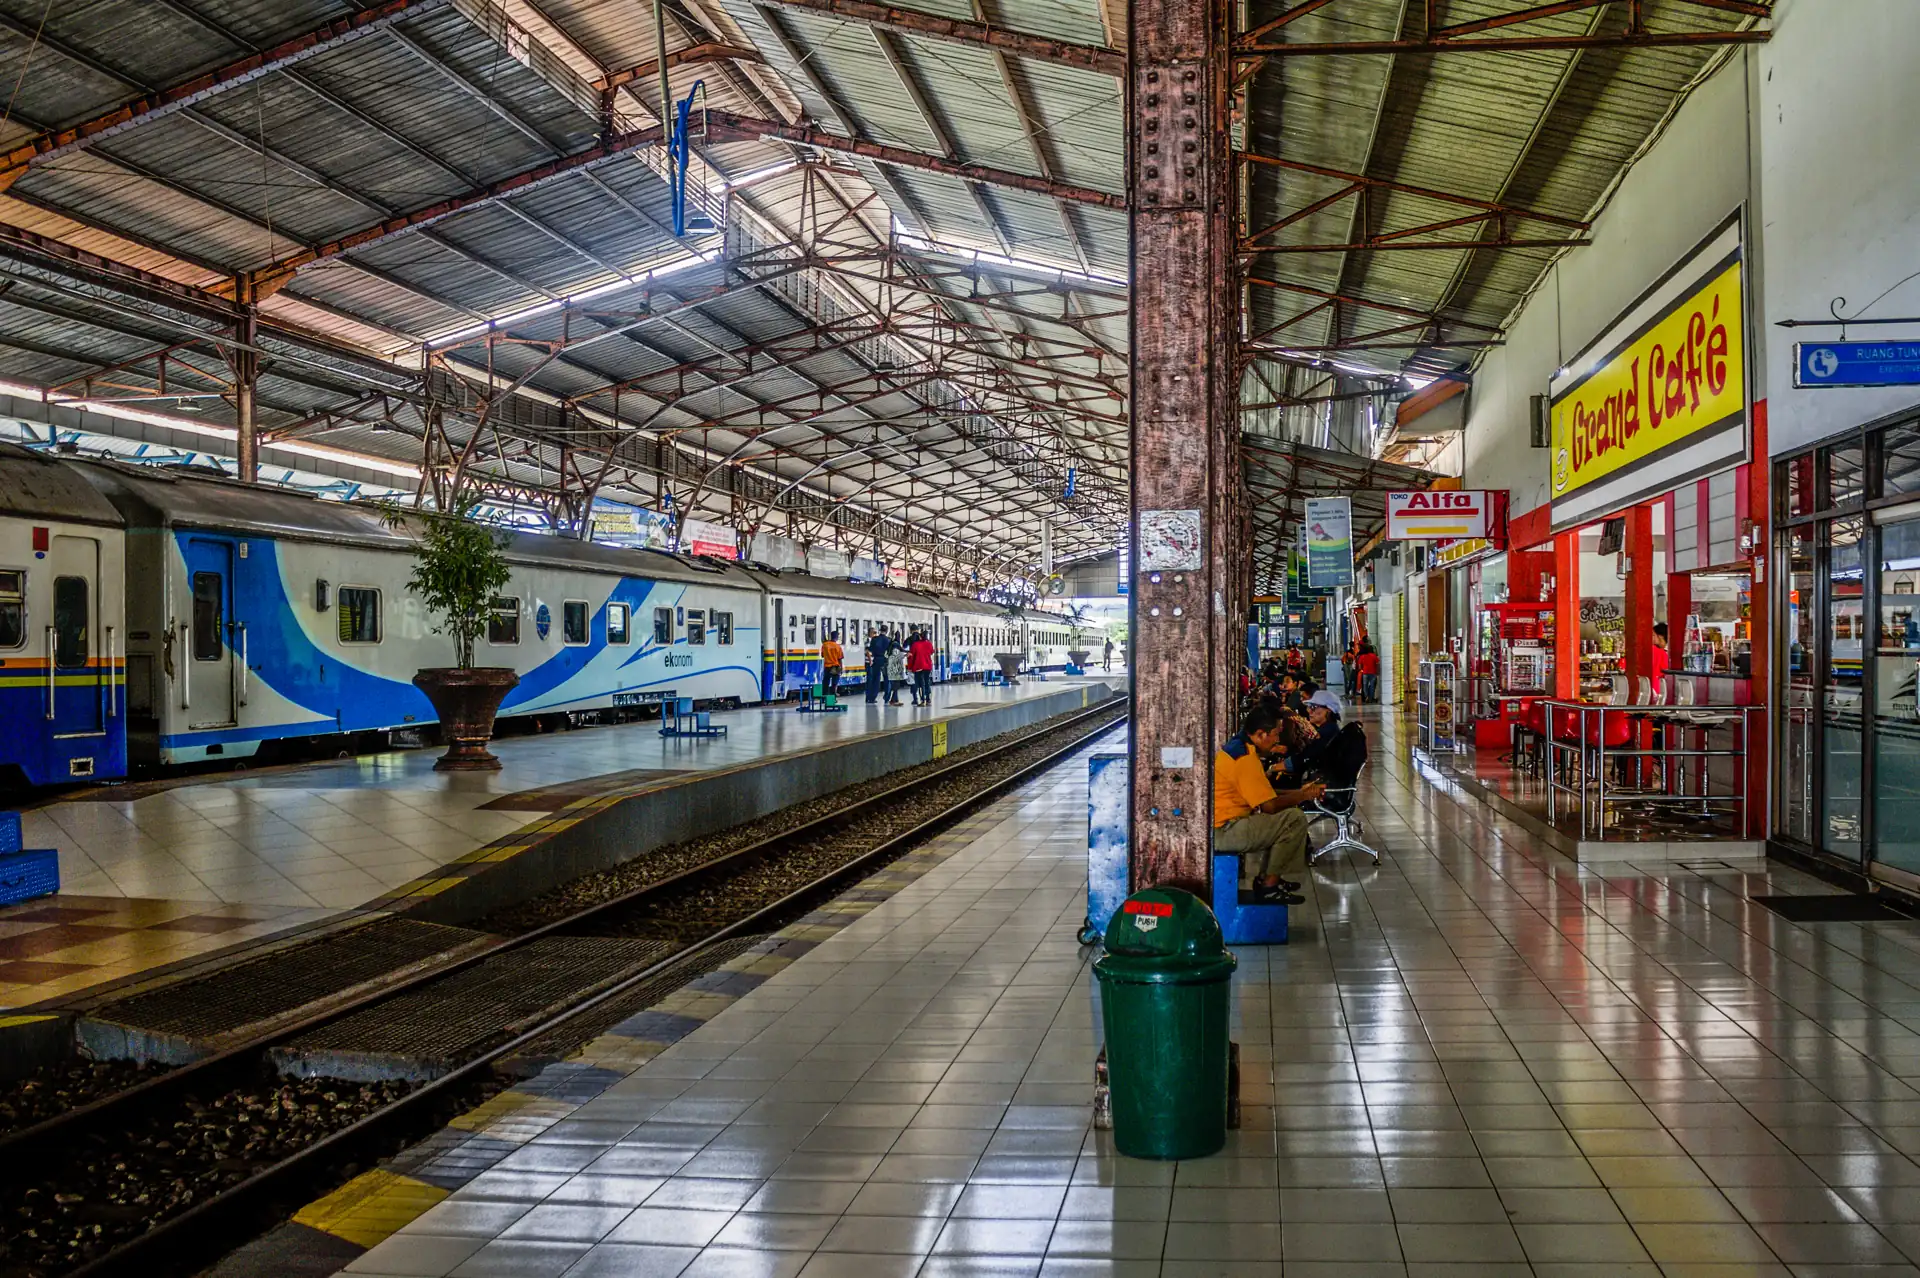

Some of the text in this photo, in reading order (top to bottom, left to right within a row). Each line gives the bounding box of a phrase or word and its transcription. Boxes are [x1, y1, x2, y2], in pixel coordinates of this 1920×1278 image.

[1856, 347, 1920, 359] RUANG TUN
[1571, 293, 1728, 473] Grand Café
[1407, 492, 1471, 509] Alfa
[1580, 602, 1617, 623] Coklat
[664, 651, 693, 668] ekonomi
[1137, 916, 1156, 926] PUSH
